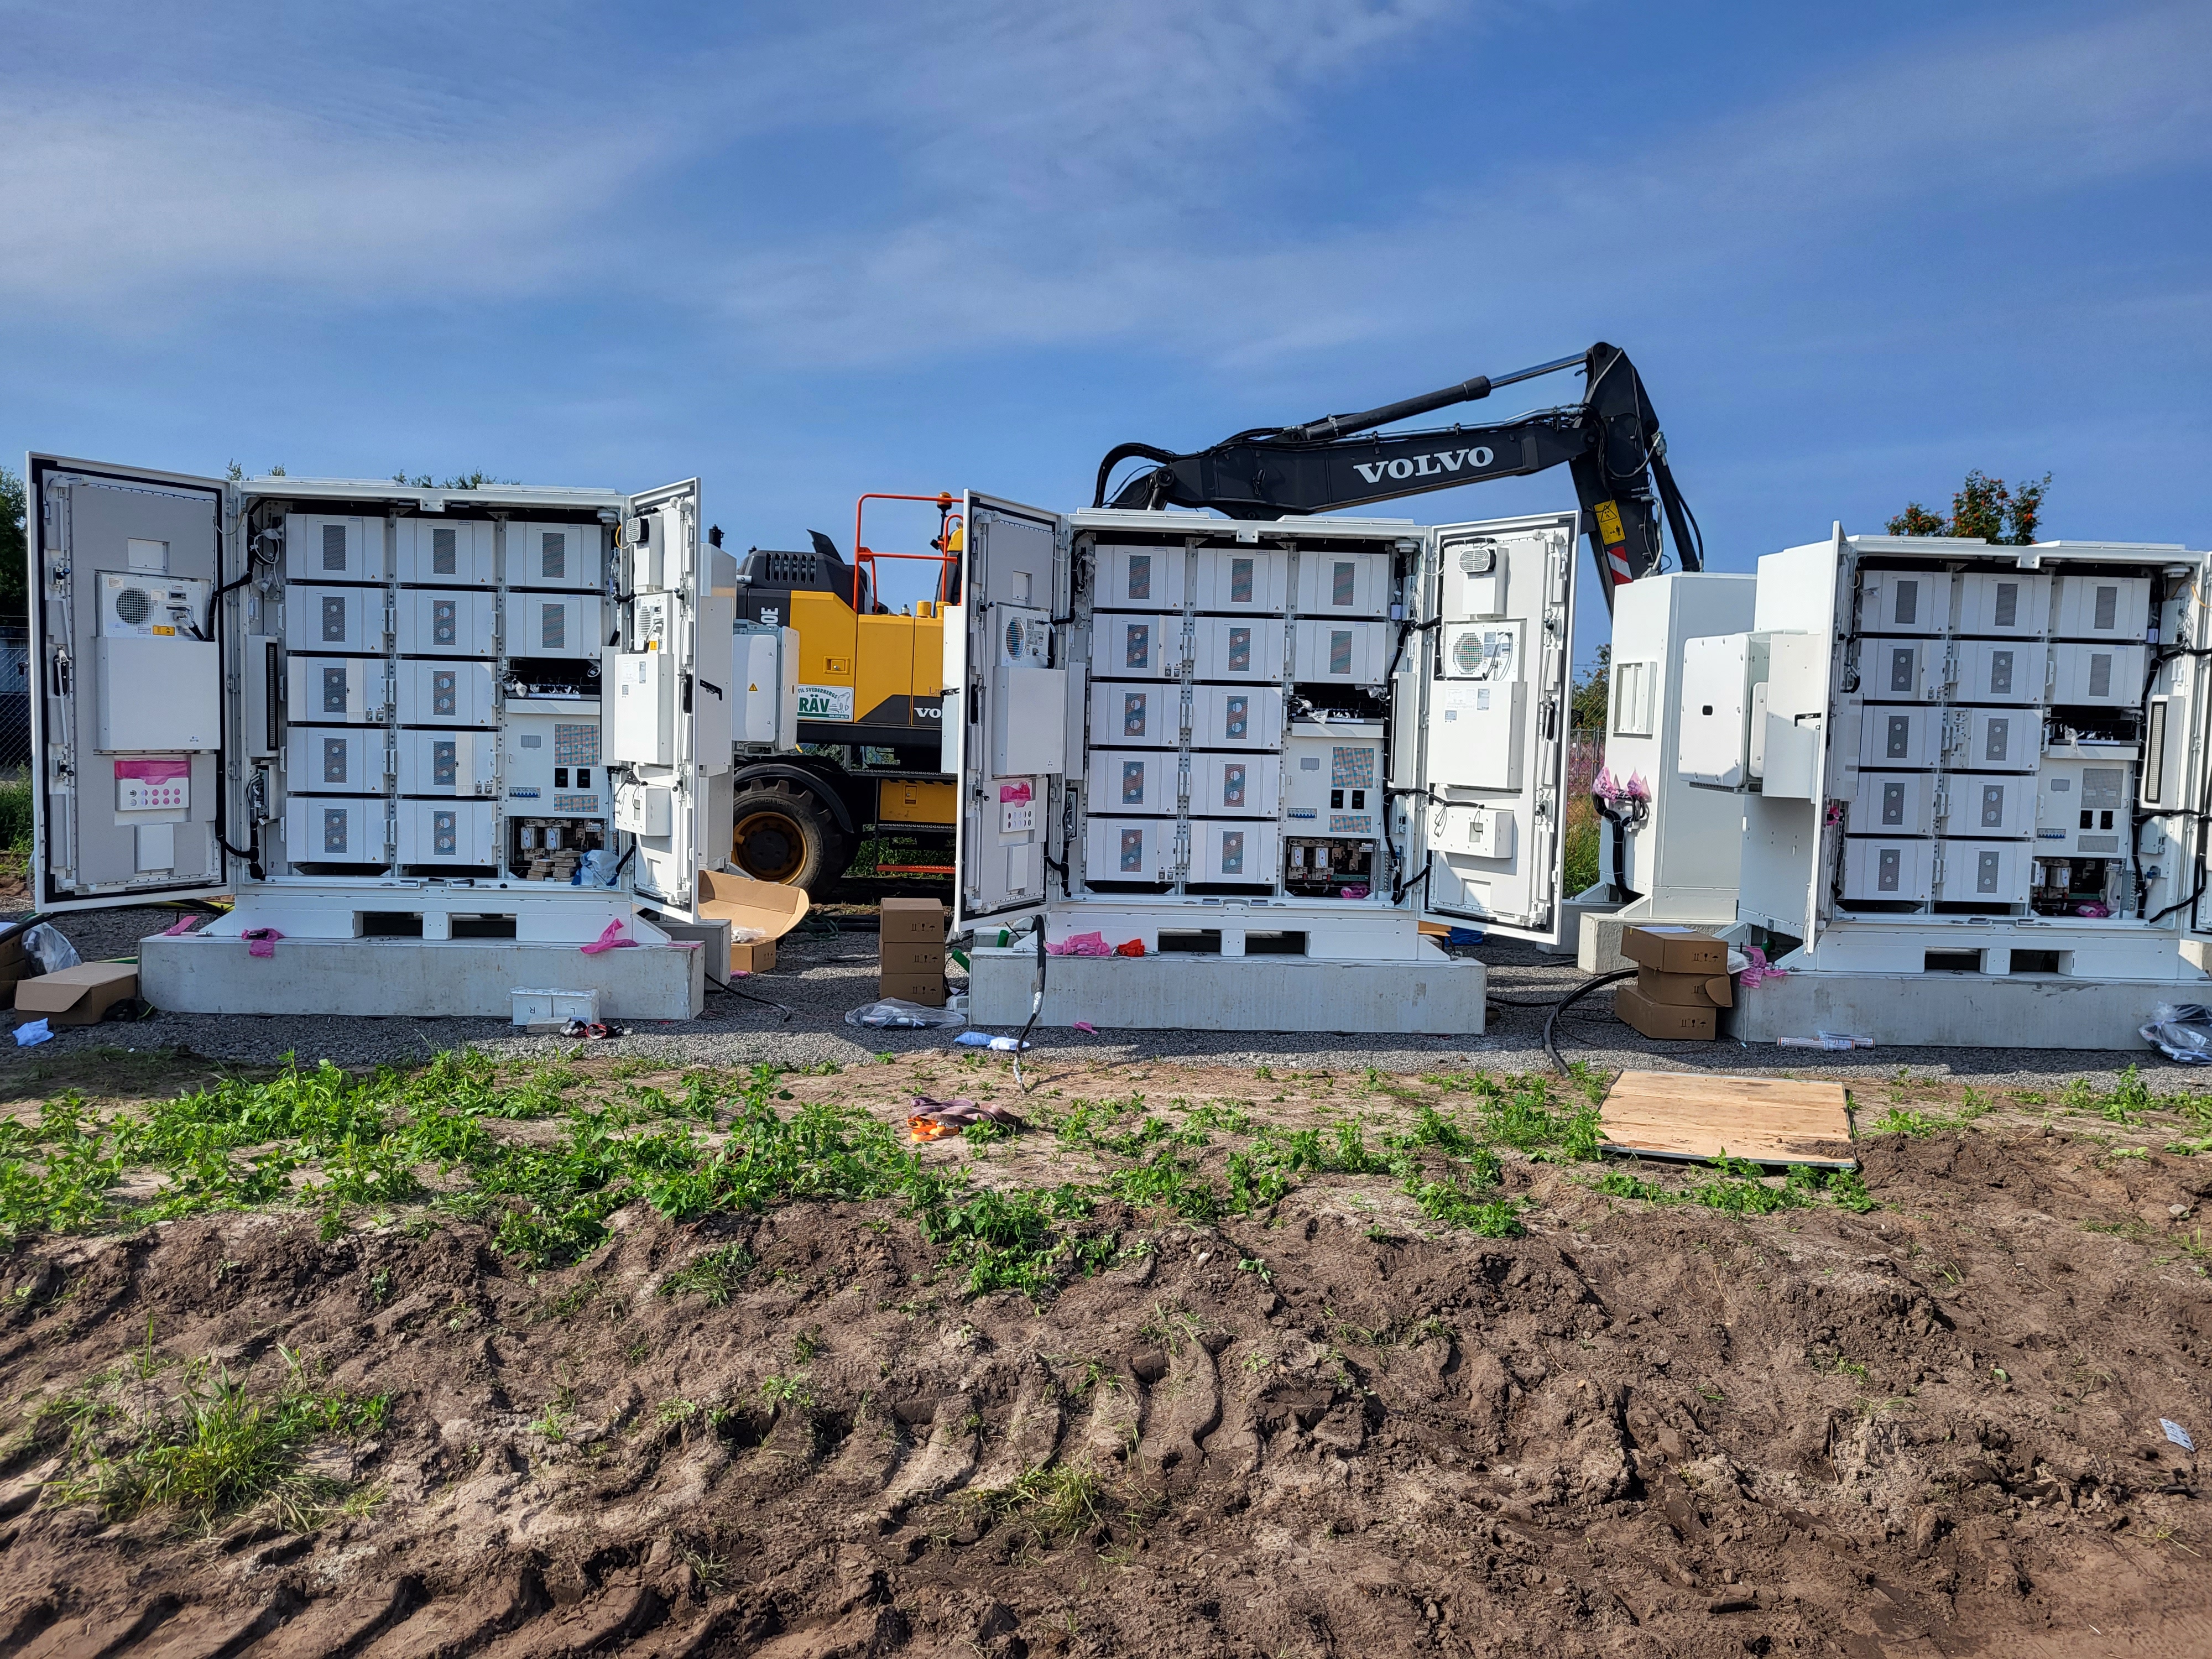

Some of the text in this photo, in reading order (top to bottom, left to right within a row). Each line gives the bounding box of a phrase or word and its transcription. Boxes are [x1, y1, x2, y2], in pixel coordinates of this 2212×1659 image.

[1353, 446, 1494, 484] VOLVO
[760, 607, 779, 627] 0E
[806, 687, 838, 698] SVEDERBERGS
[799, 694, 830, 712] RÄV
[914, 707, 943, 718] VO
[529, 1006, 536, 1014] R
